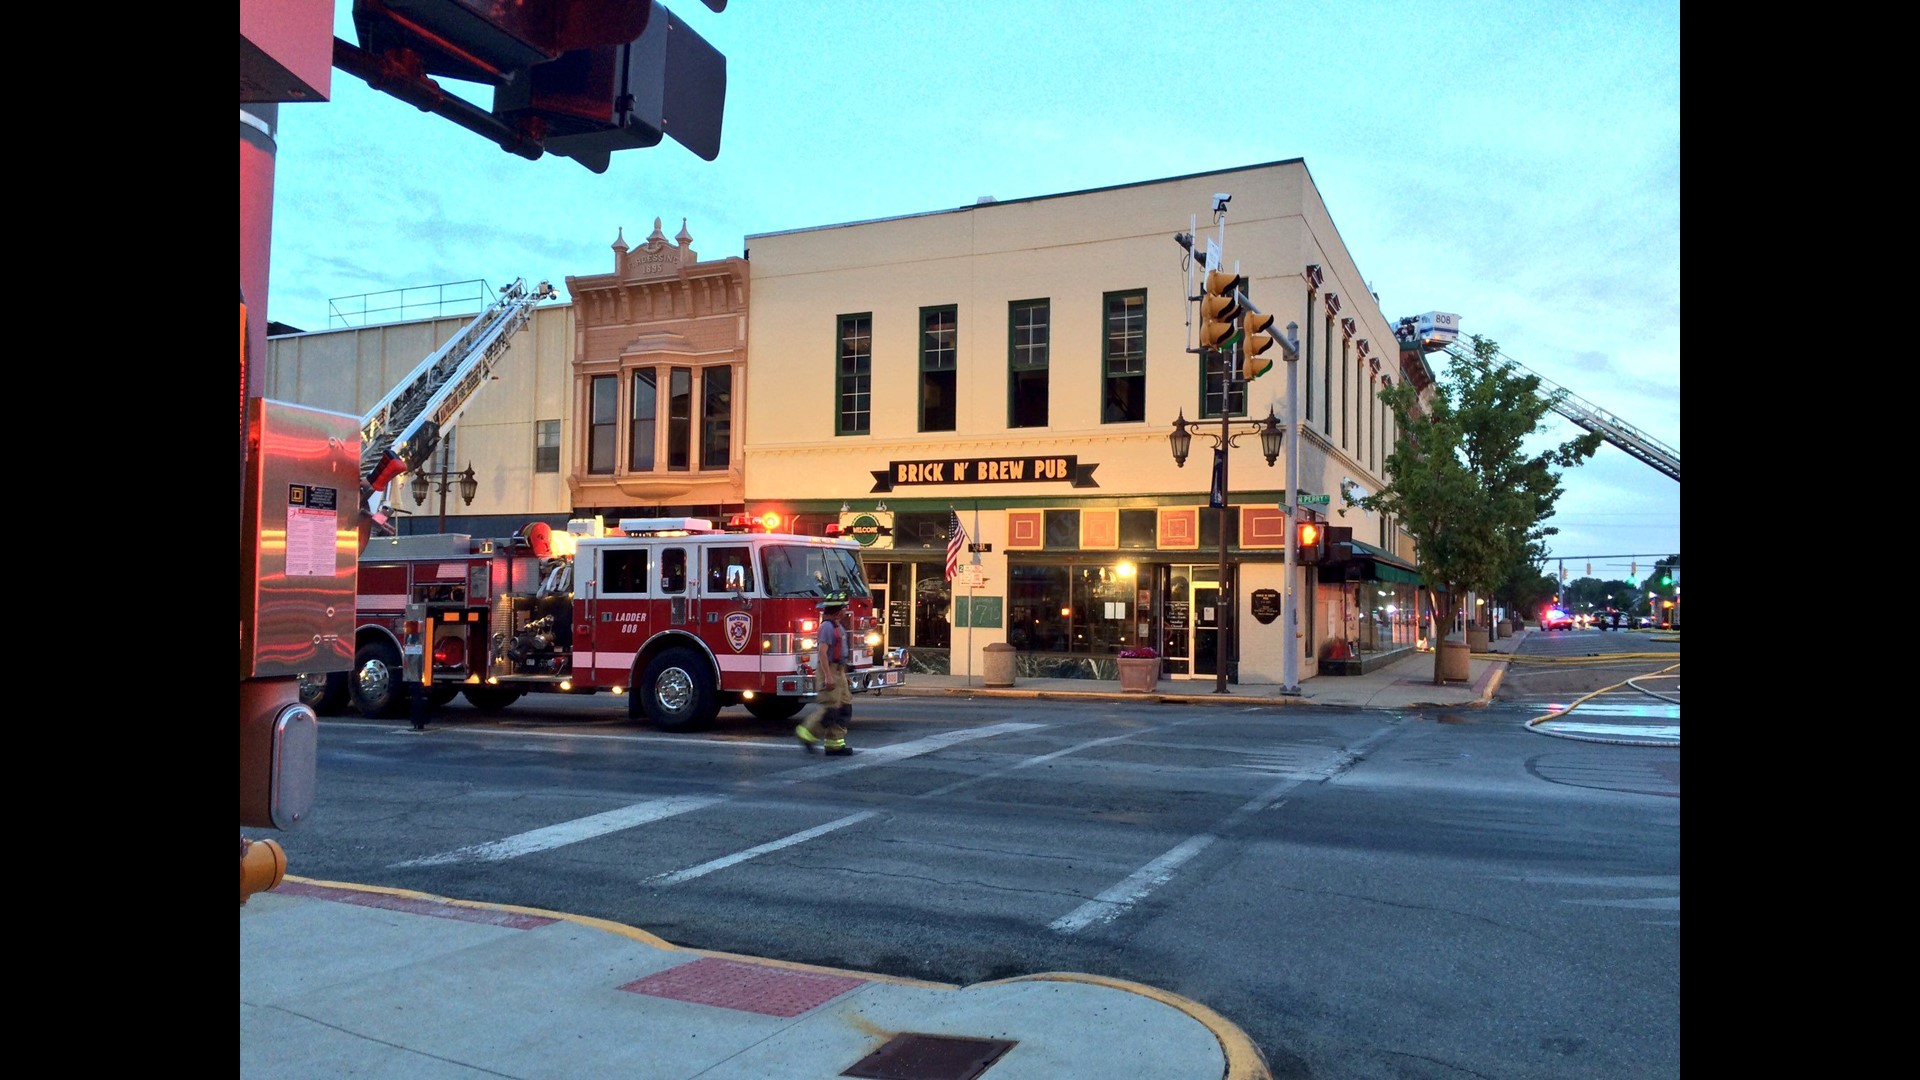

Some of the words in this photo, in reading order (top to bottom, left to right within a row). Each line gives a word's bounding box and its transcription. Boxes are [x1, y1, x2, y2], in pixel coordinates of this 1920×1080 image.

[642, 264, 663, 274] 1895
[1435, 314, 1451, 325] 808
[897, 463, 944, 483] BRICK
[977, 460, 1024, 480] BREW
[1034, 459, 1068, 479] PUB
[852, 526, 878, 534] WELCOME
[615, 612, 647, 622] LADDER
[621, 624, 637, 634] 808
